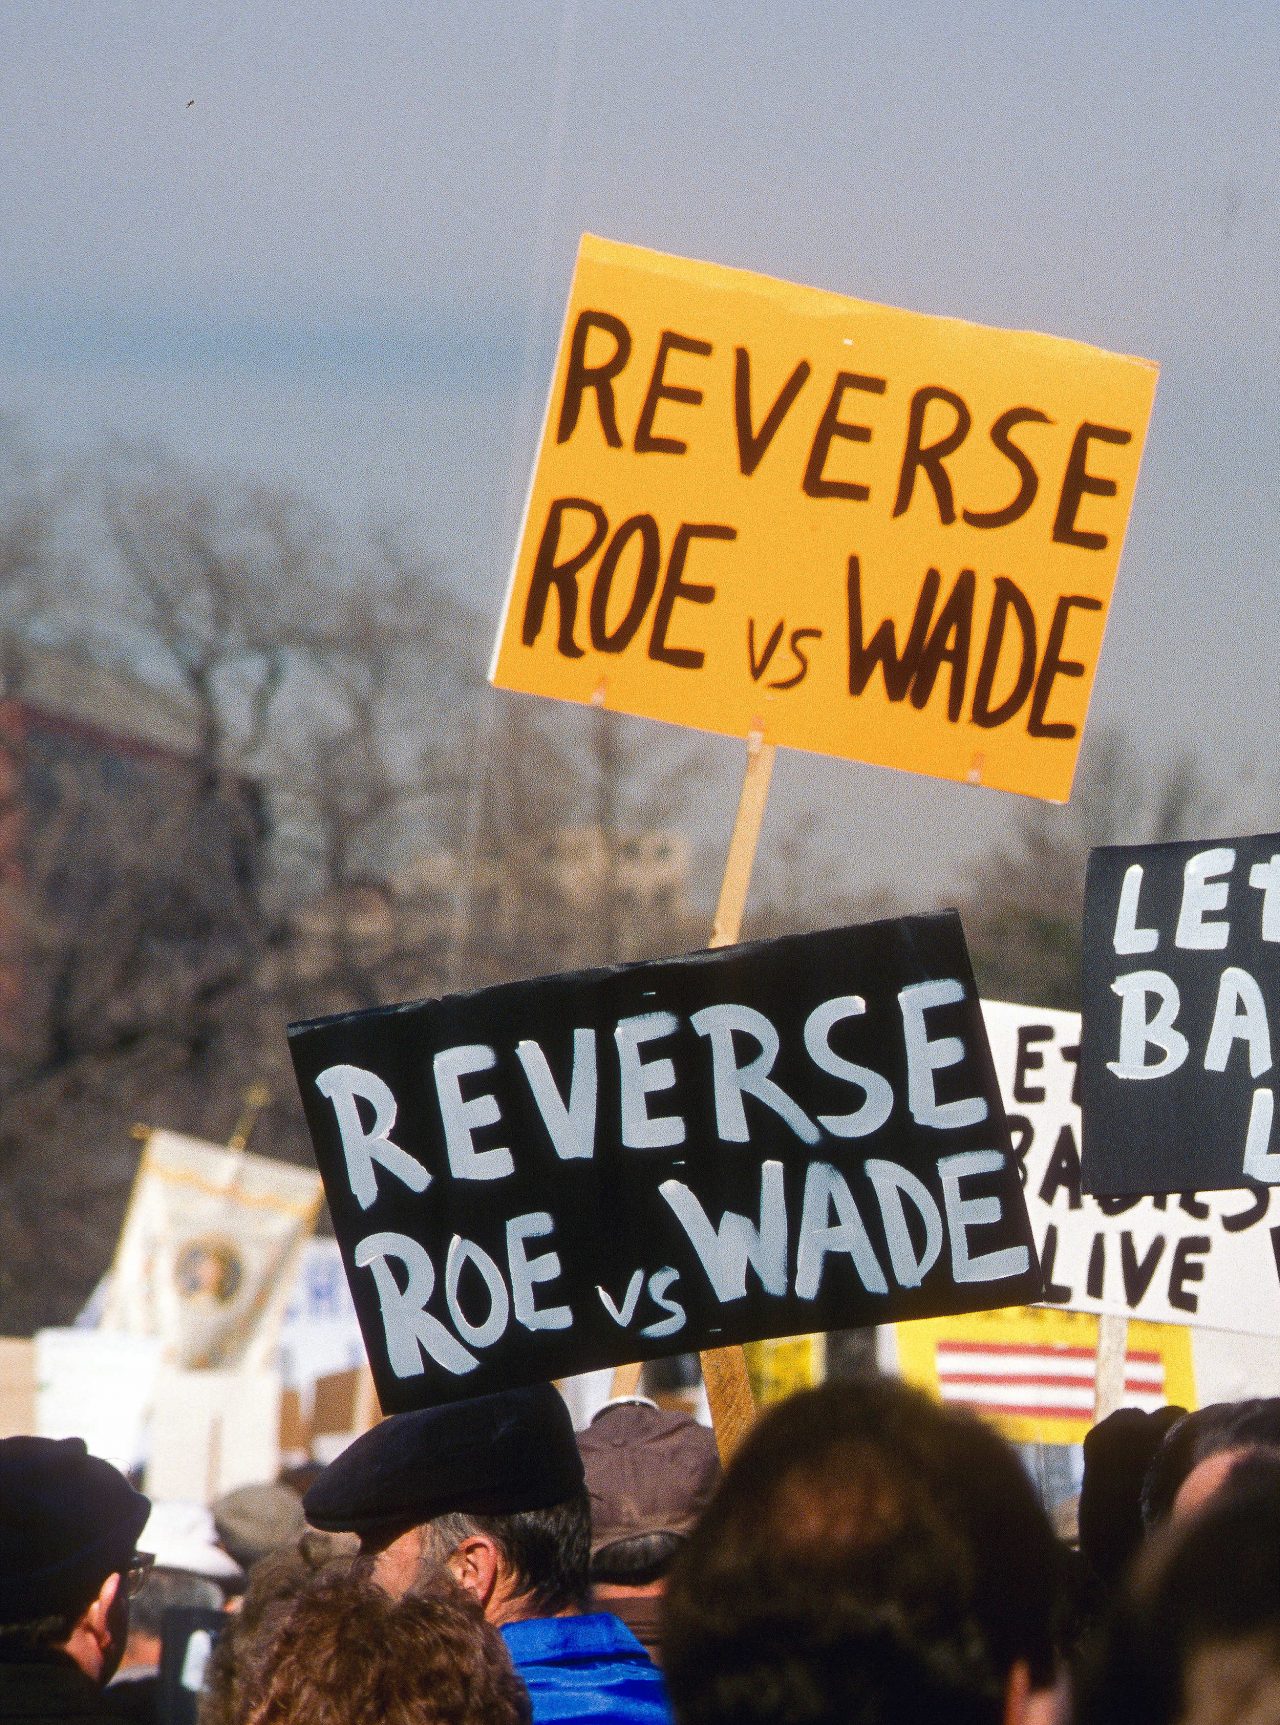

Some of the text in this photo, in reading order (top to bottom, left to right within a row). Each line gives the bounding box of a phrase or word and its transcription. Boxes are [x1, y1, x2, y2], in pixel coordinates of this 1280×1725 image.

[556, 309, 1132, 550] REVERSE
[522, 497, 737, 669] ROE
[846, 554, 1103, 739] WADE
[315, 978, 989, 1211] REVERSE
[354, 1211, 574, 1379] ROE
[658, 1148, 1030, 1303] WADE
[1040, 1223, 1212, 1315] LIVE
